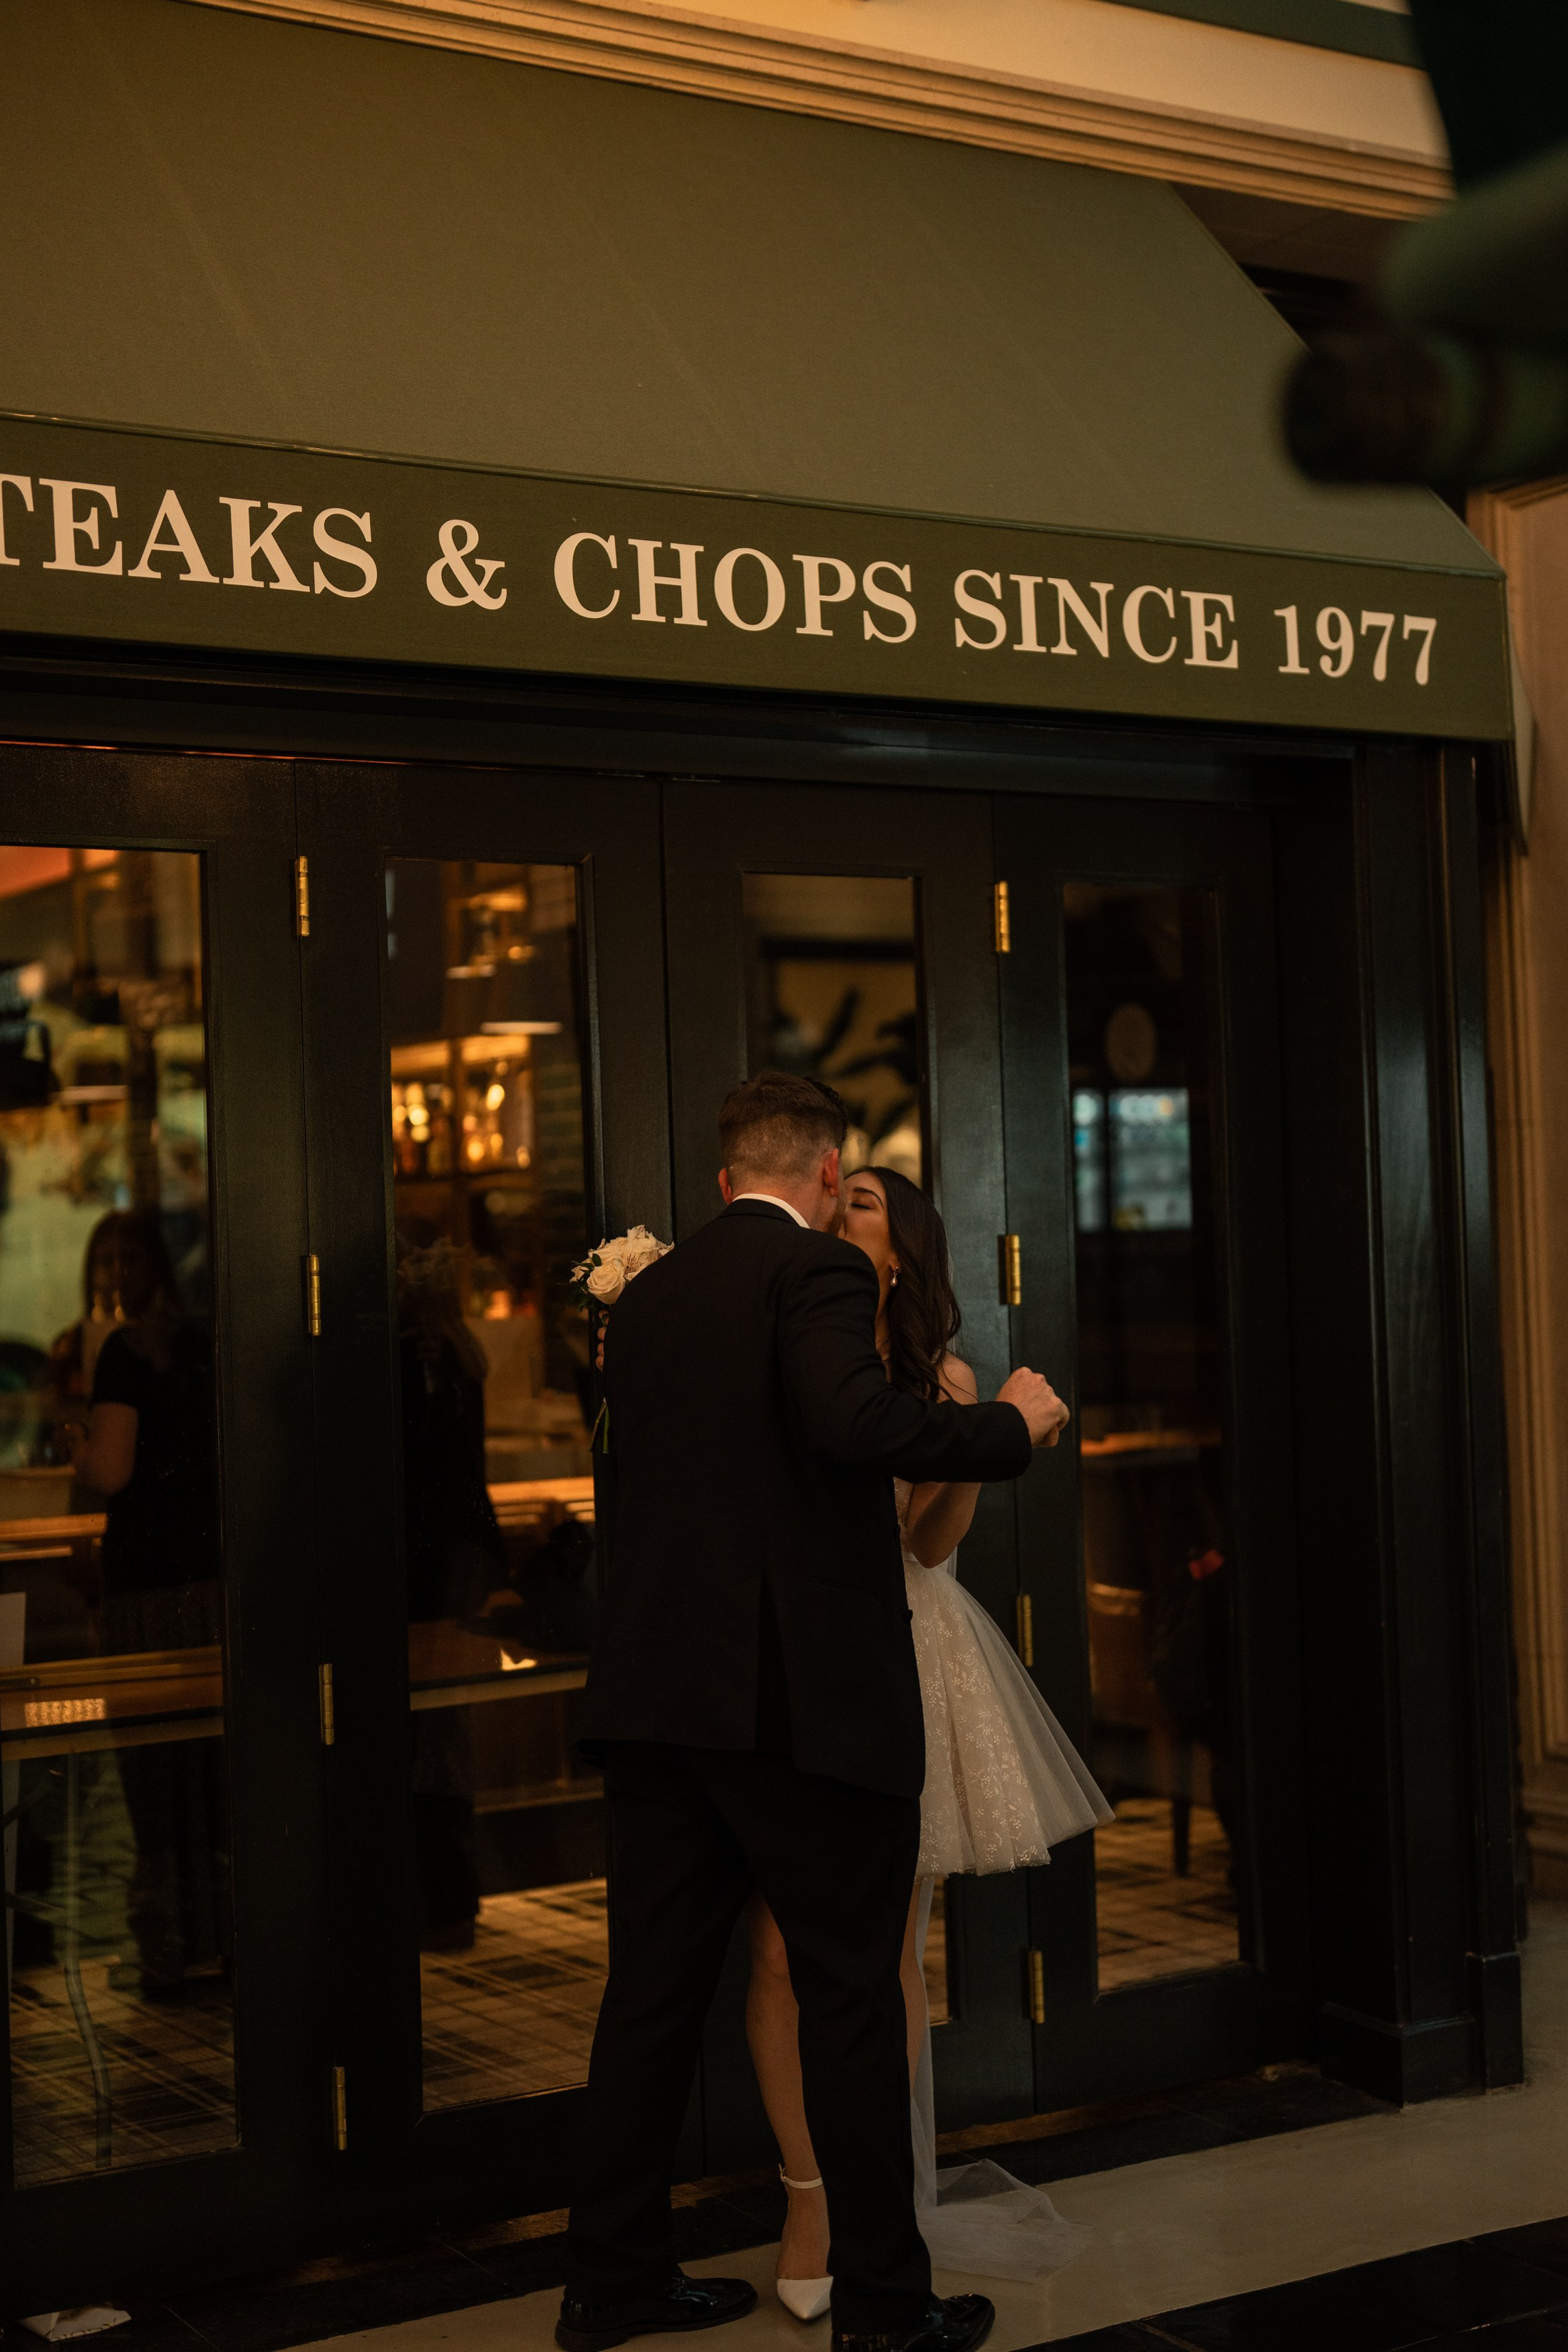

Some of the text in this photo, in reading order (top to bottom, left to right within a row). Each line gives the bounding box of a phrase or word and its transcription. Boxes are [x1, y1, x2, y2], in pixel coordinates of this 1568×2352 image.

[426, 519, 507, 610] &
[554, 532, 917, 643] CHOPS
[954, 569, 1238, 669] SINCE
[1274, 604, 1437, 685] 1977
